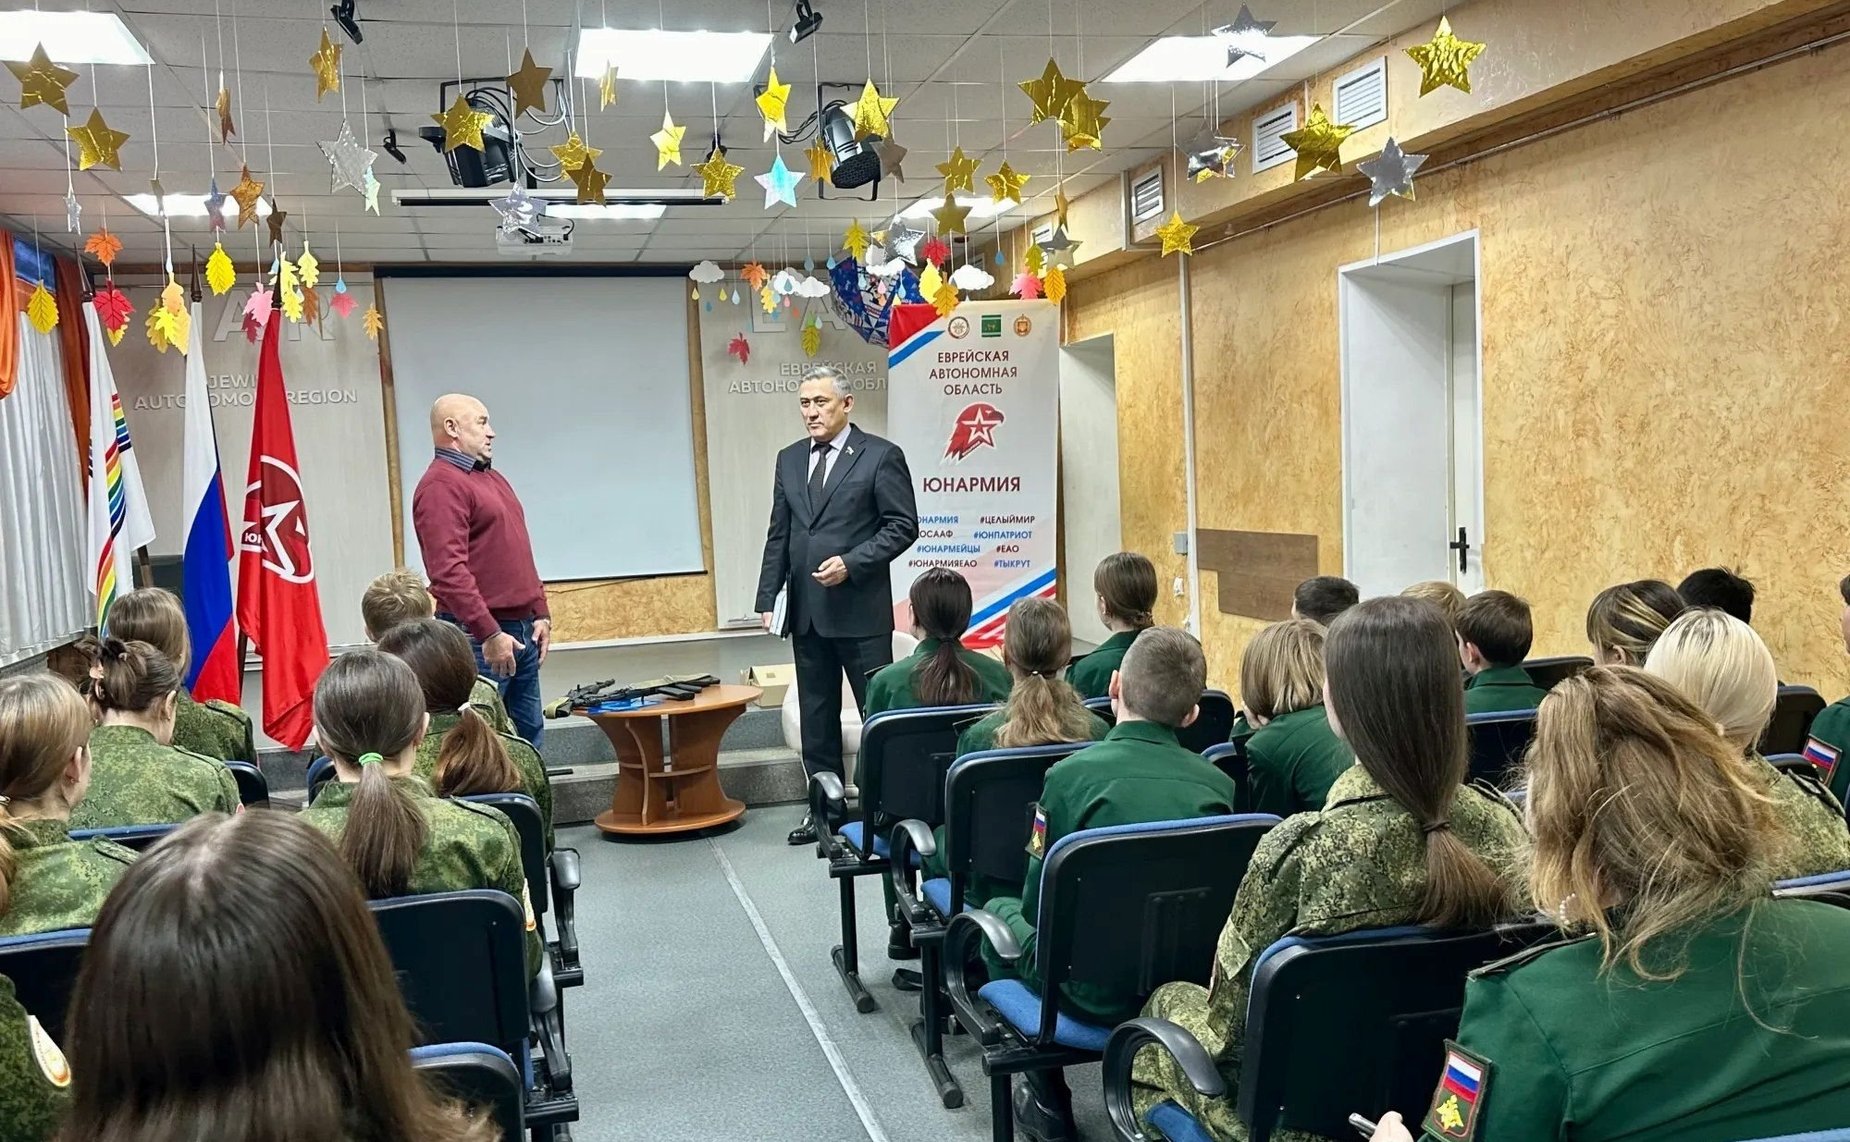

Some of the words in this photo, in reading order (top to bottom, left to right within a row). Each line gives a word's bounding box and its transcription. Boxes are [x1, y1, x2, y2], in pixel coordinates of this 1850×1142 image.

[938, 349, 1009, 363] ЕВРЕЙСКАЯ
[929, 366, 1017, 380] АВТОНОМНАЯ
[208, 374, 257, 389] JEWI
[729, 379, 799, 393] АВТОНО
[853, 377, 886, 391] ОБЛ
[285, 388, 358, 405] REGION
[943, 383, 1003, 396] ОБЛАСТЬ
[923, 476, 1021, 493] ЮНАРМИЯ
[980, 514, 1035, 525] #ЦЕЛЫЙМИР
[919, 530, 954, 539] ОСААФ
[973, 530, 1032, 540] #ЮНПАТРИОТ
[917, 543, 981, 554] #ЮНАРМЕЙЦЫ
[996, 544, 1020, 553] #ЕАО
[908, 559, 978, 568] #ЮНАРМИЯЕАО
[994, 559, 1031, 568] #ТЫКРУТ
